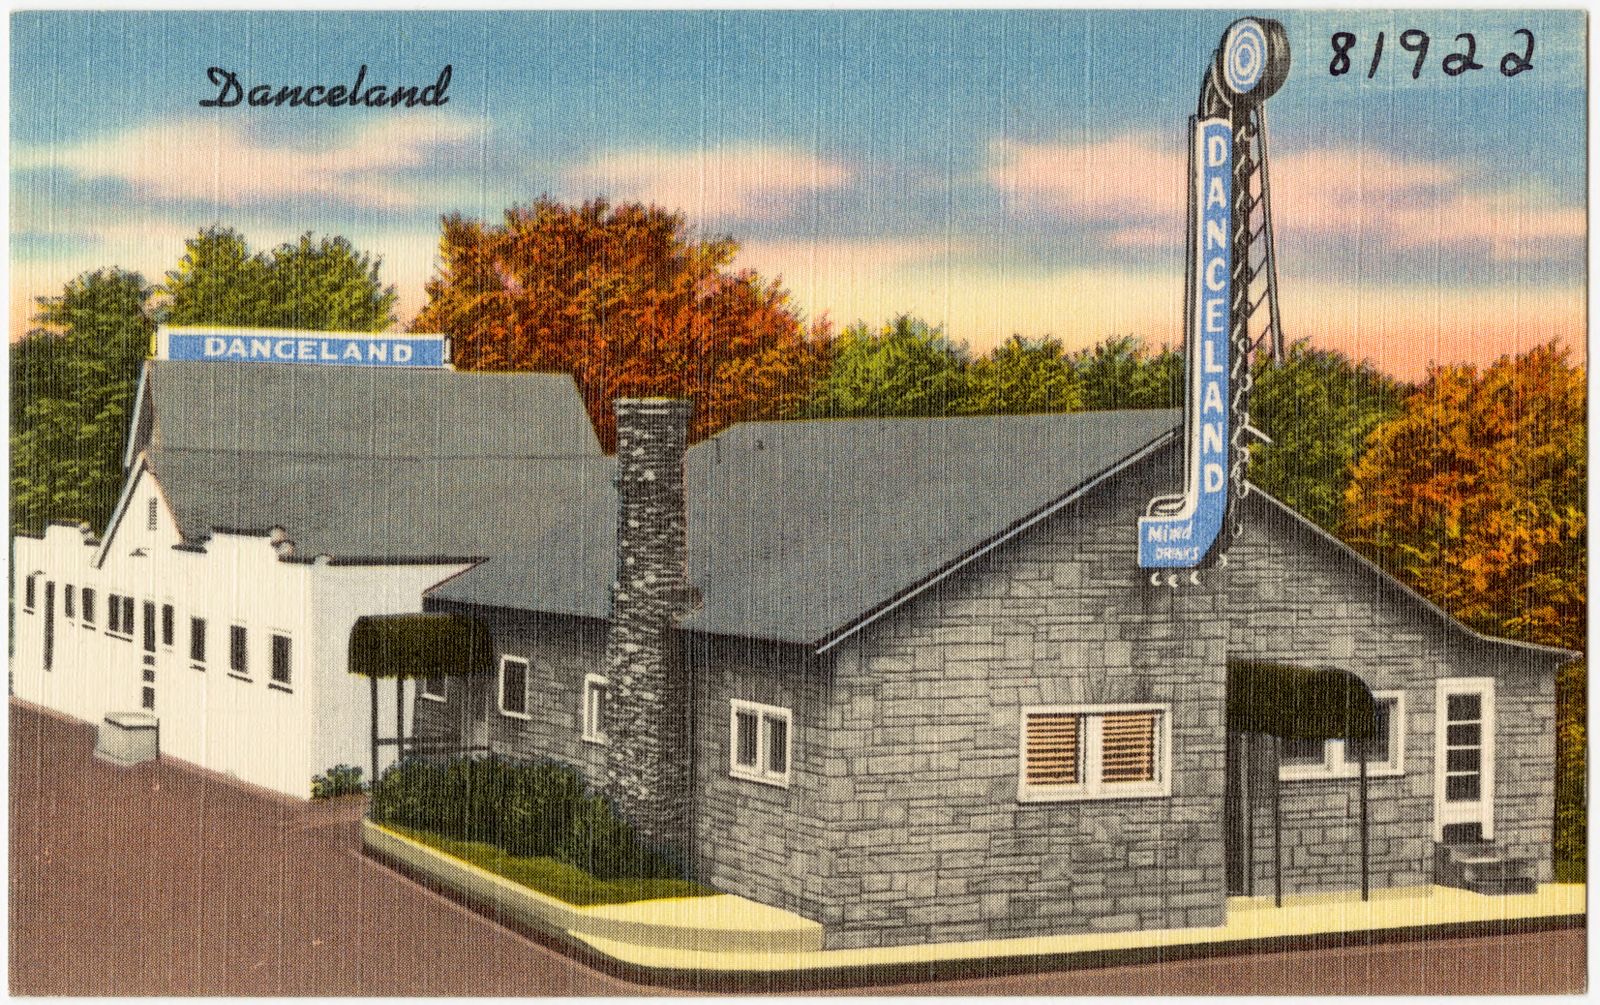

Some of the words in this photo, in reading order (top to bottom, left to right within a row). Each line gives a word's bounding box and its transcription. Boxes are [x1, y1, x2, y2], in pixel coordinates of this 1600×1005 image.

[1329, 29, 1535, 79] 81922
[1203, 135, 1229, 494] DANCELAND
[204, 337, 412, 363] DANCELAND
